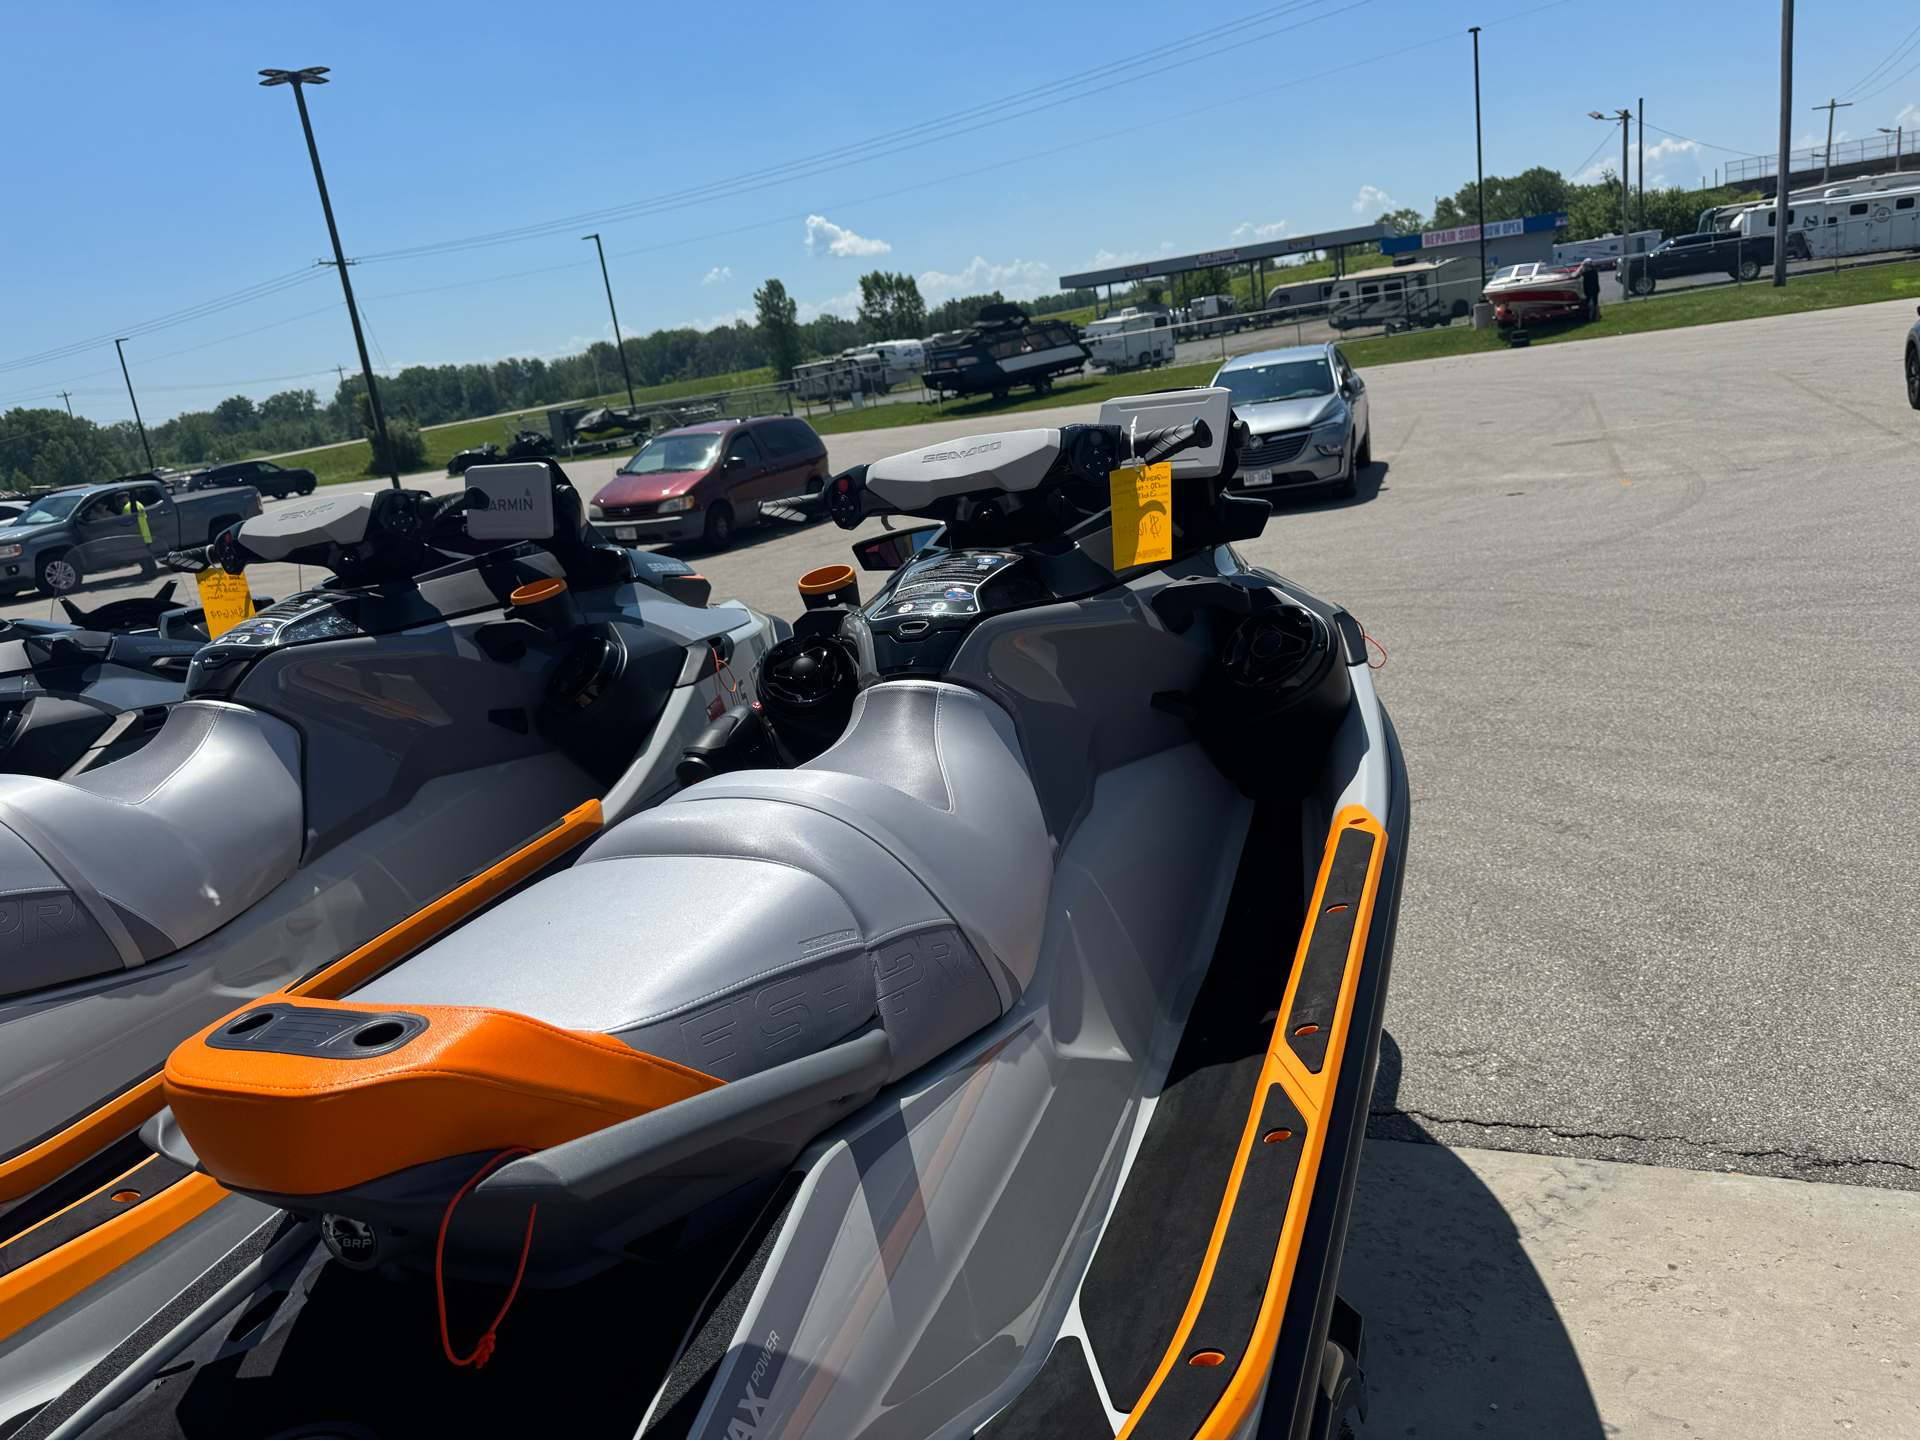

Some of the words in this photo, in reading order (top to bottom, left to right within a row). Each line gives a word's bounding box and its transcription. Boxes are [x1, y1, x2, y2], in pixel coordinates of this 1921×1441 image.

[1424, 231, 1456, 246] REPAIR
[1502, 220, 1521, 235] OPEN
[482, 498, 533, 512] ARMIN
[343, 1238, 373, 1249] BRP
[751, 1329, 780, 1387] POWER
